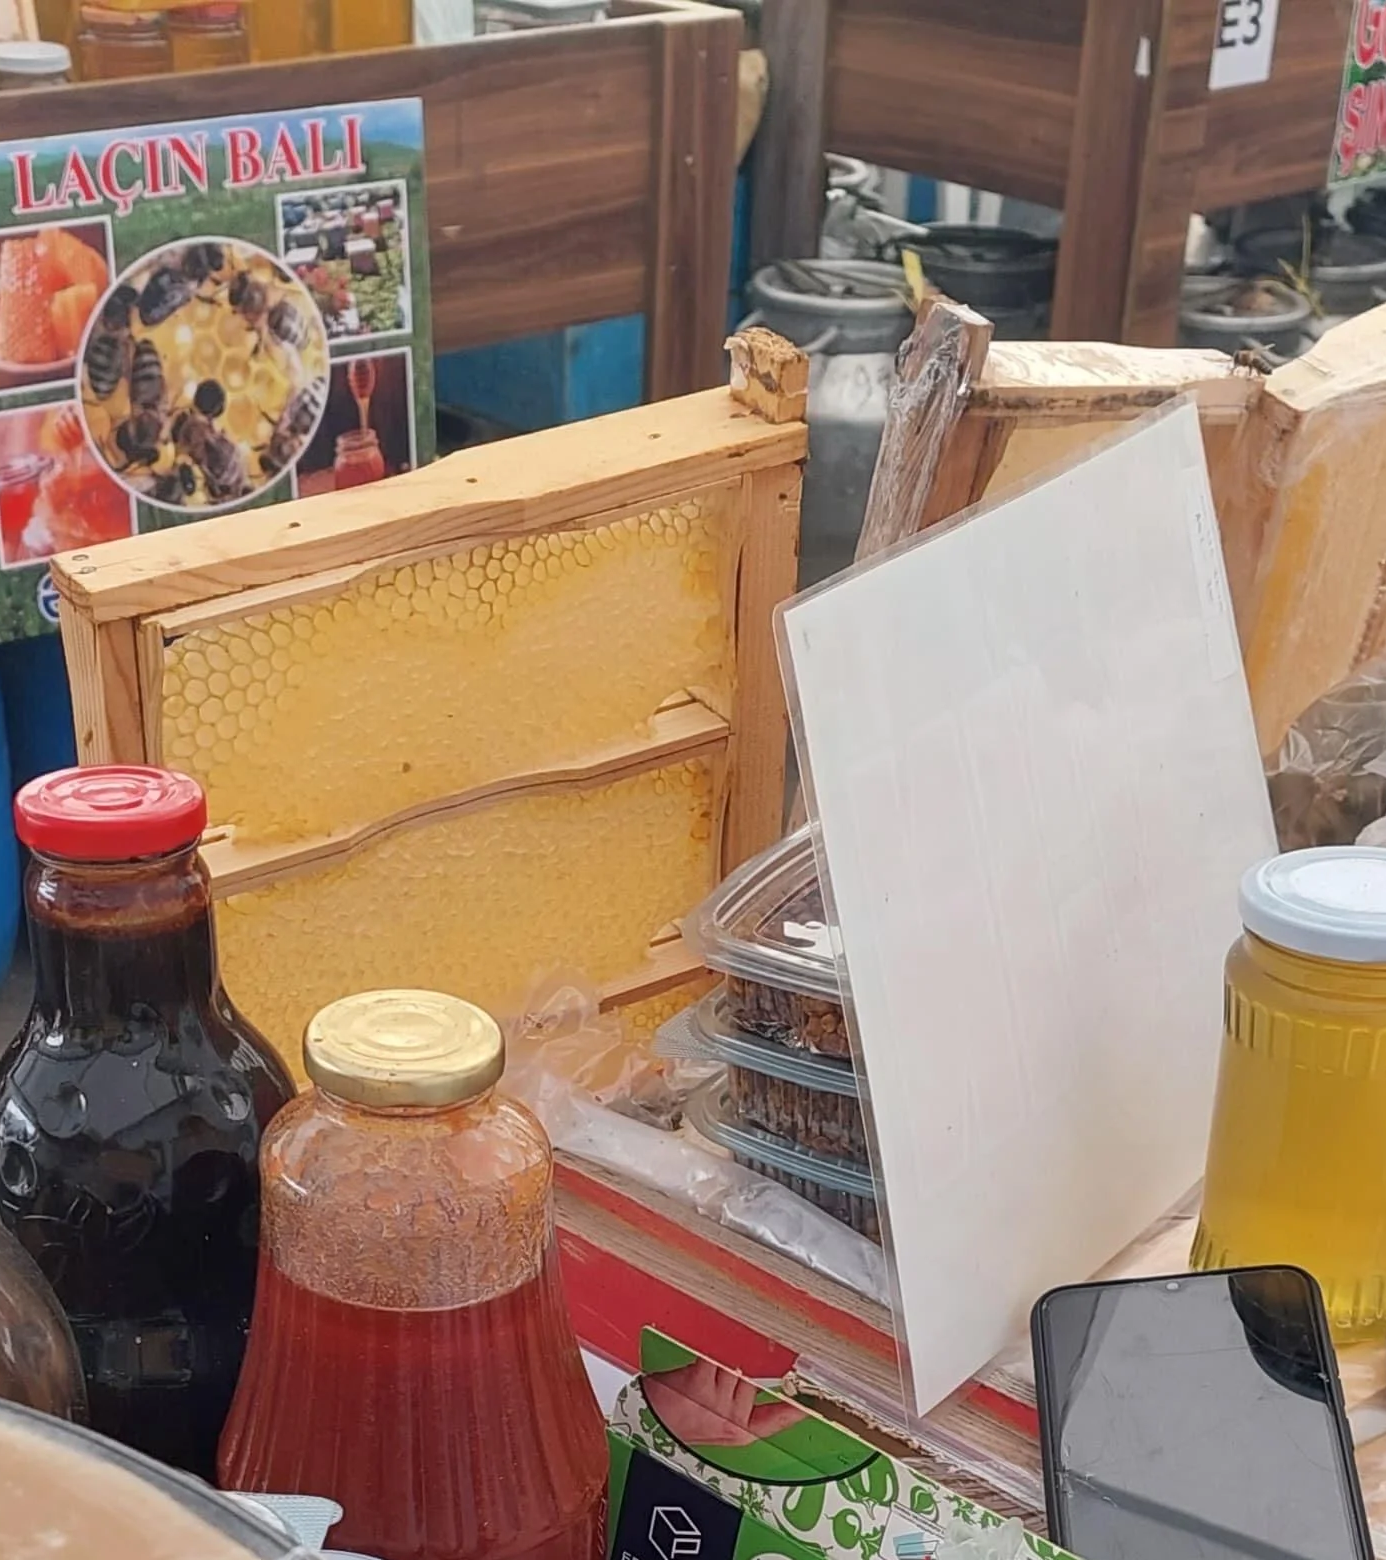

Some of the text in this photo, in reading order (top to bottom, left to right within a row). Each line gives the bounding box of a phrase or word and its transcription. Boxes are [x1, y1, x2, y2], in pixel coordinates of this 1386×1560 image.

[1216, 0, 1261, 49] E3
[10, 115, 365, 216] LAÇIN BALI
